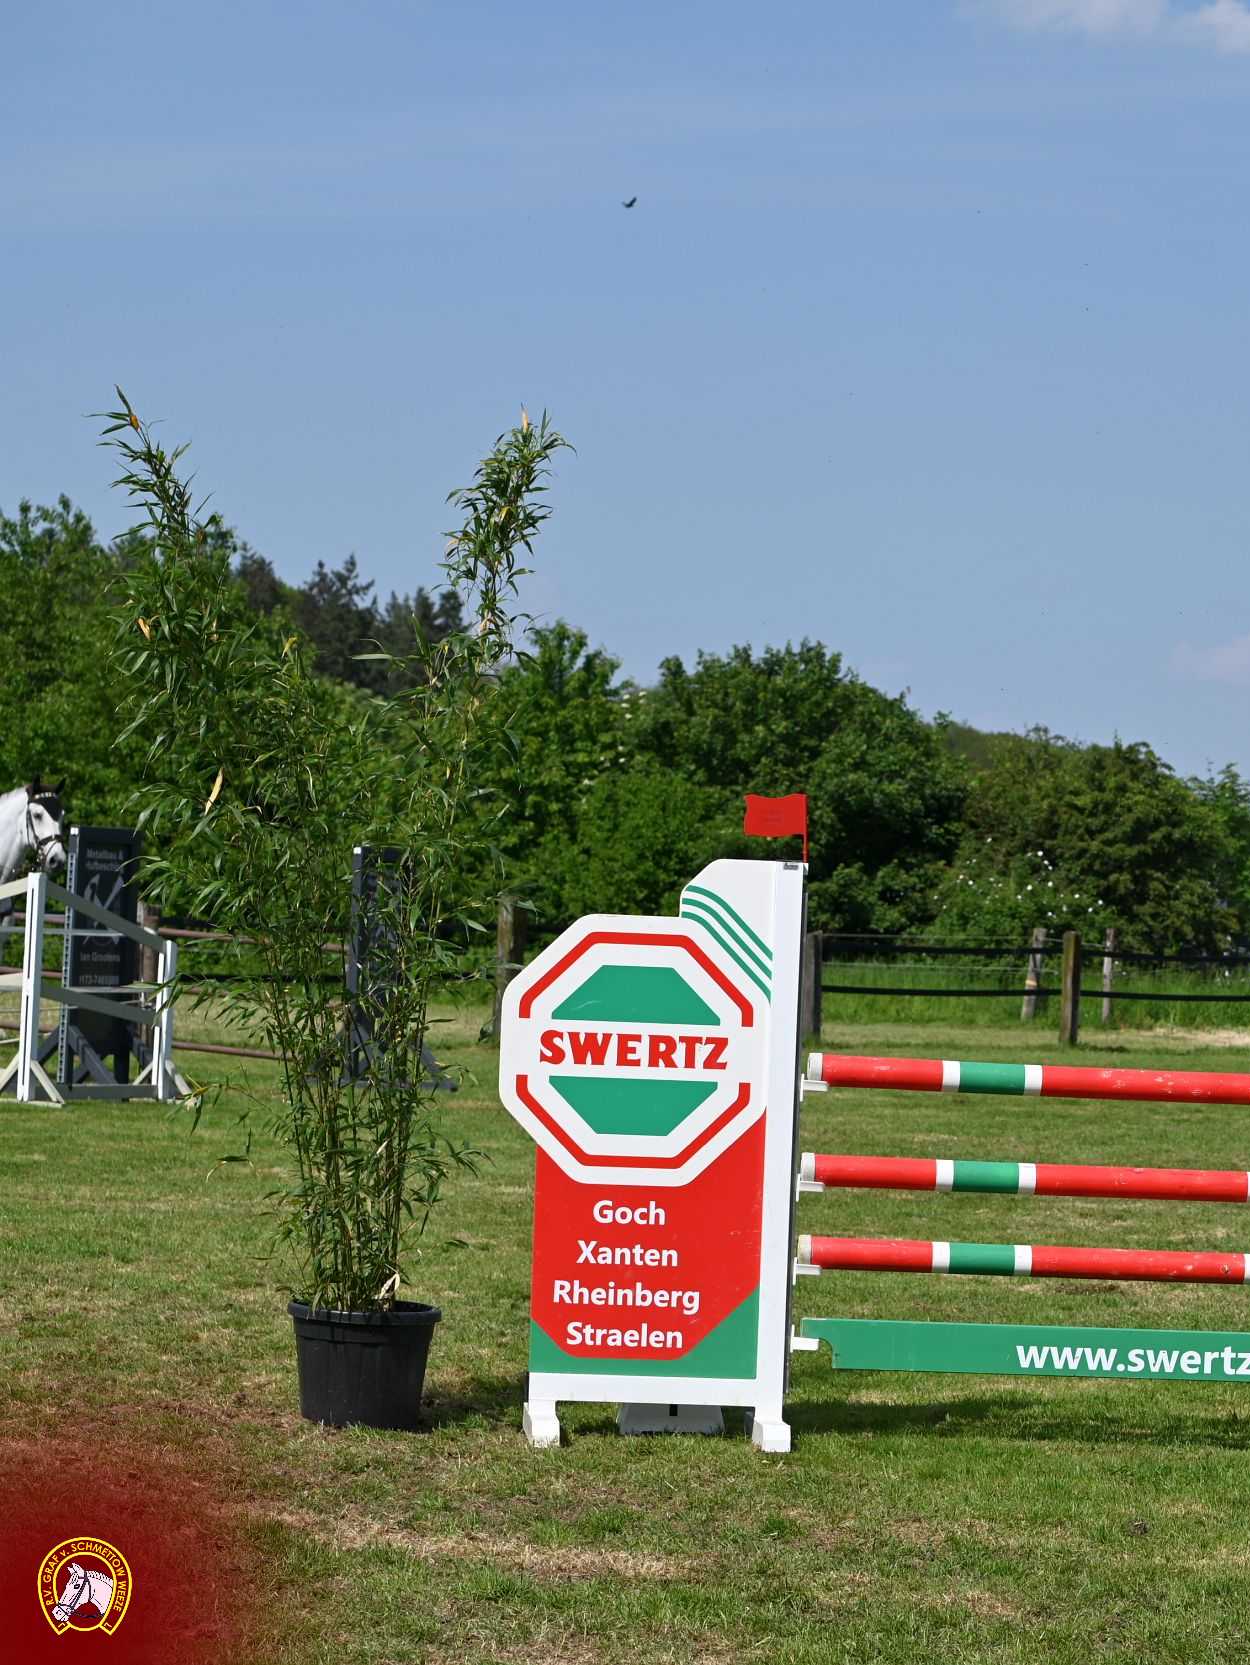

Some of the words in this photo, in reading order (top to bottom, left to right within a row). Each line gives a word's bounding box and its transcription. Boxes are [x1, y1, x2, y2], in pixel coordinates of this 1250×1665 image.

[539, 1029, 729, 1070] SWERTZ
[592, 1199, 666, 1226] Goch
[576, 1240, 678, 1267] Xanten
[553, 1279, 700, 1315] Rheinberg
[566, 1321, 683, 1349] Straelen
